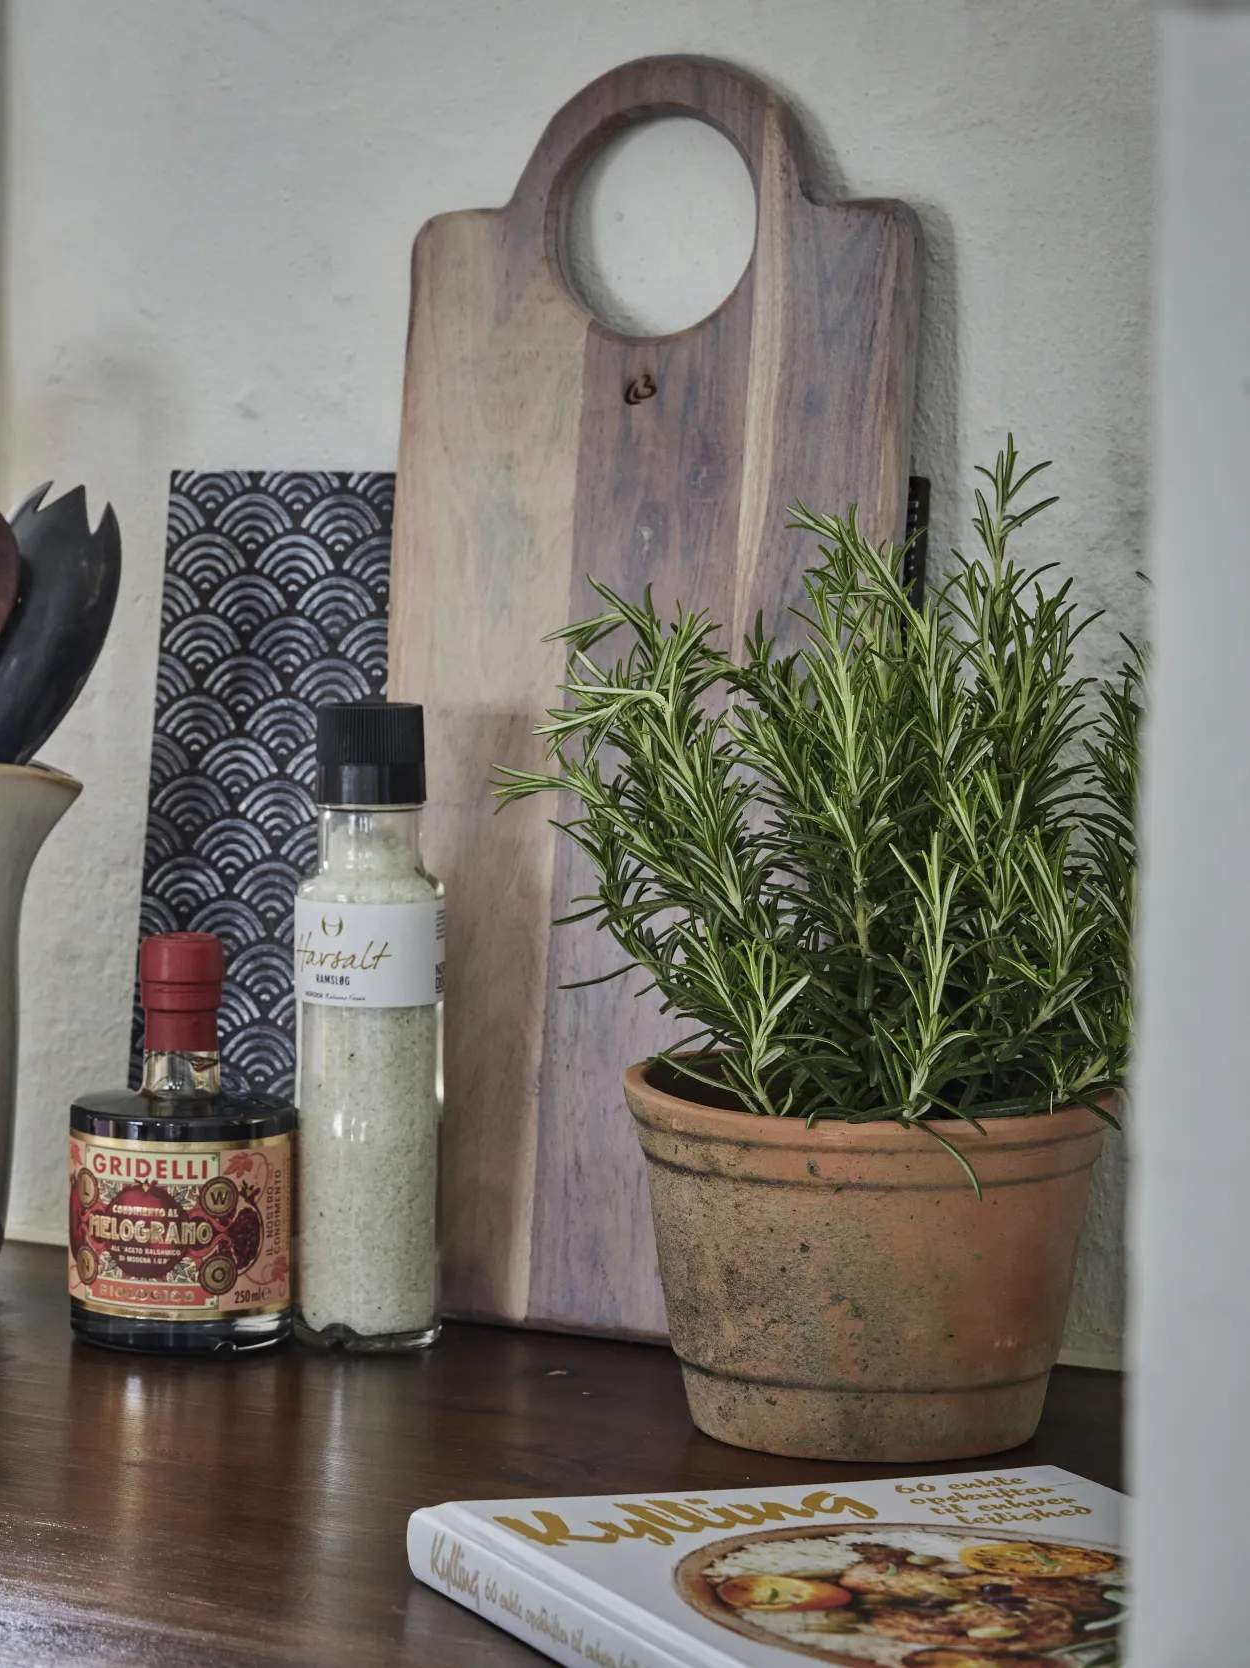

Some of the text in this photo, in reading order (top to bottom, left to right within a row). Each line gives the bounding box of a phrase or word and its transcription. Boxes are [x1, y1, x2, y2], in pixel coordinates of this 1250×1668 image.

[297, 931, 393, 972] Havsalt
[92, 1152, 208, 1180] GRIDELLI
[112, 1204, 179, 1218] CONDIMENTO AL
[210, 1191, 229, 1206] W
[273, 1169, 281, 1255] CONDIMENTO
[88, 1213, 214, 1245] MELOGRANO
[894, 1476, 1028, 1494] 60 enkle
[910, 1486, 1056, 1505] opskrifter
[493, 1490, 879, 1546] Kylling
[930, 1496, 1078, 1516] til enhver
[430, 1529, 480, 1610] Kylling
[484, 1575, 497, 1604] 60
